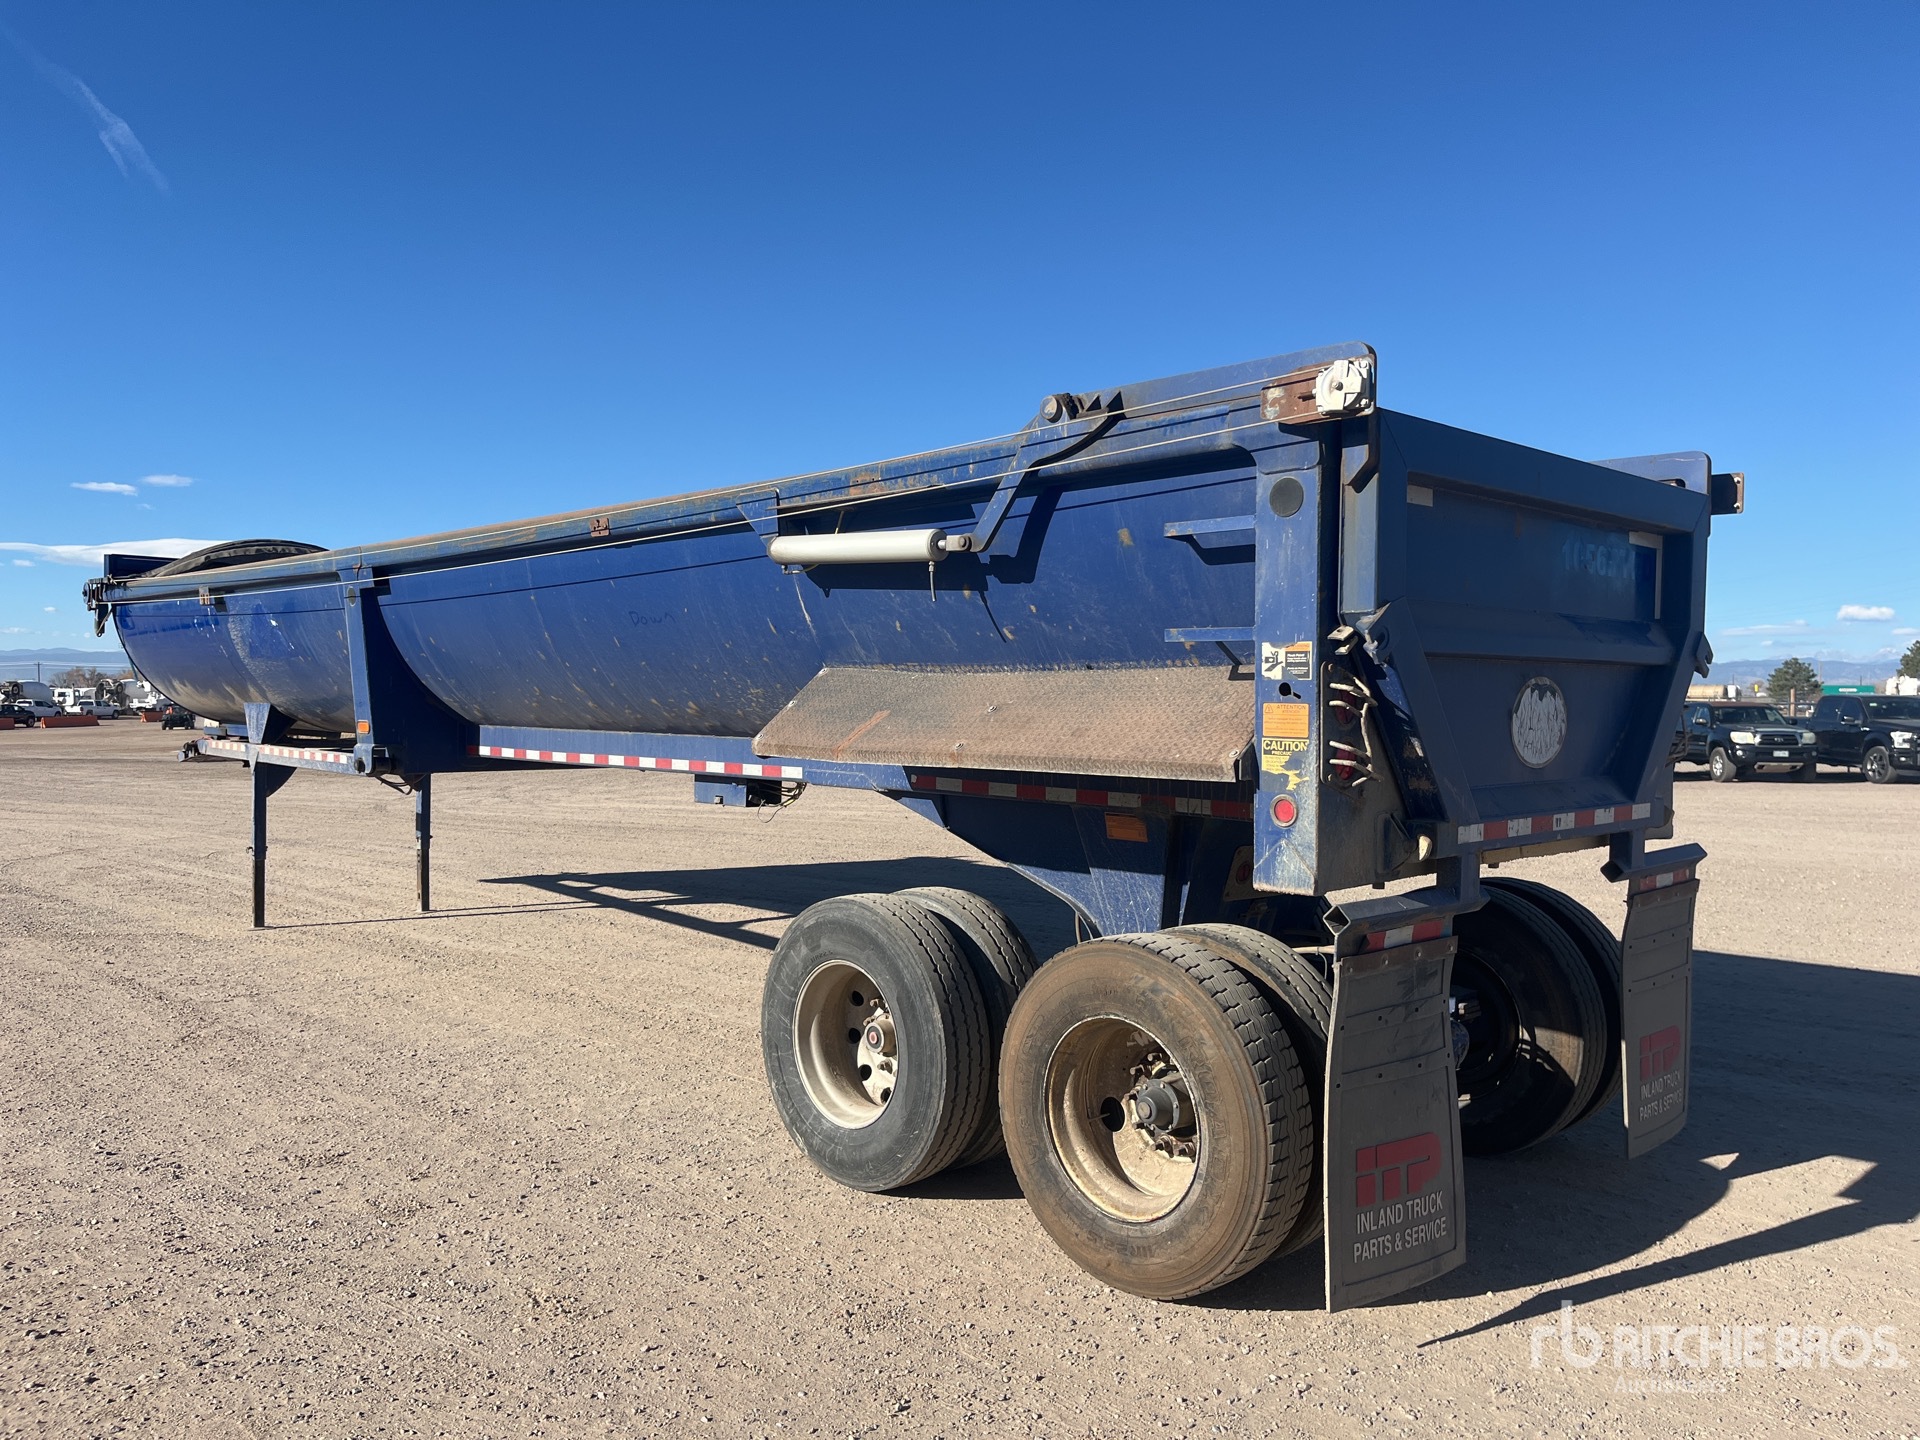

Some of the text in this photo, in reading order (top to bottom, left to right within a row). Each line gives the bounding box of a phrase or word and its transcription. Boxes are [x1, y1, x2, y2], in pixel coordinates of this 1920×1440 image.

[628, 610, 676, 627] Down
[1263, 740, 1308, 751] CAUTION
[1640, 1070, 1681, 1101] INLAND TRUCK
[1639, 1099, 1659, 1122] PARTS
[1356, 1190, 1443, 1235] INLAND TRUCK
[1353, 1217, 1447, 1264] PARTS & SERVICE
